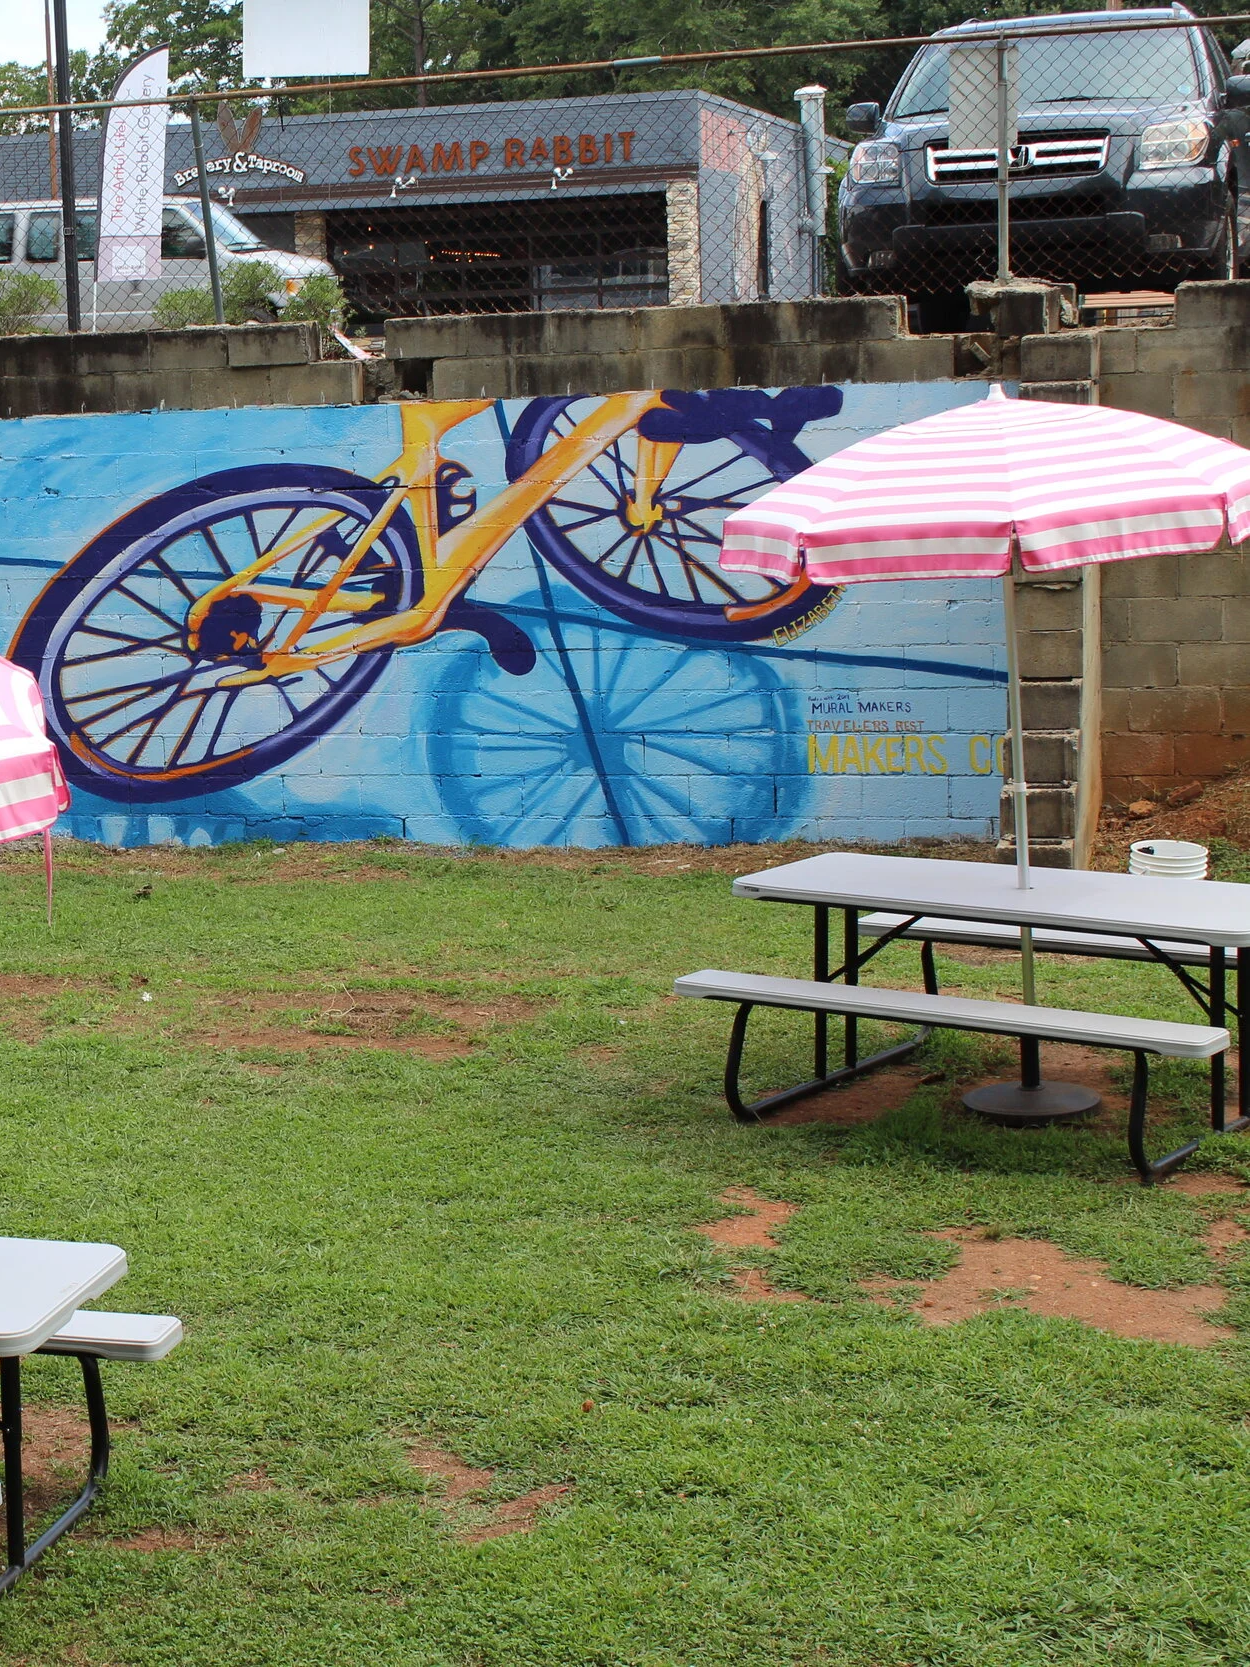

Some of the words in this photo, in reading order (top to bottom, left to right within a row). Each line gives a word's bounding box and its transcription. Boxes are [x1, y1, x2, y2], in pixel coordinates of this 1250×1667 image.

[137, 74, 156, 130] Gaery
[113, 155, 126, 190] Artful
[136, 134, 150, 183] Rabbit
[173, 158, 232, 188] Breery
[247, 154, 304, 183] Taproom
[348, 140, 490, 177] SWAMP
[504, 130, 637, 168] RABBIT
[110, 195, 124, 221] The
[134, 187, 149, 232] White
[806, 720, 889, 732] TRAVELERS
[895, 720, 925, 732] REST
[811, 702, 853, 714] MURAL
[858, 701, 912, 713] MAKERS
[807, 734, 948, 775] MAKERS
